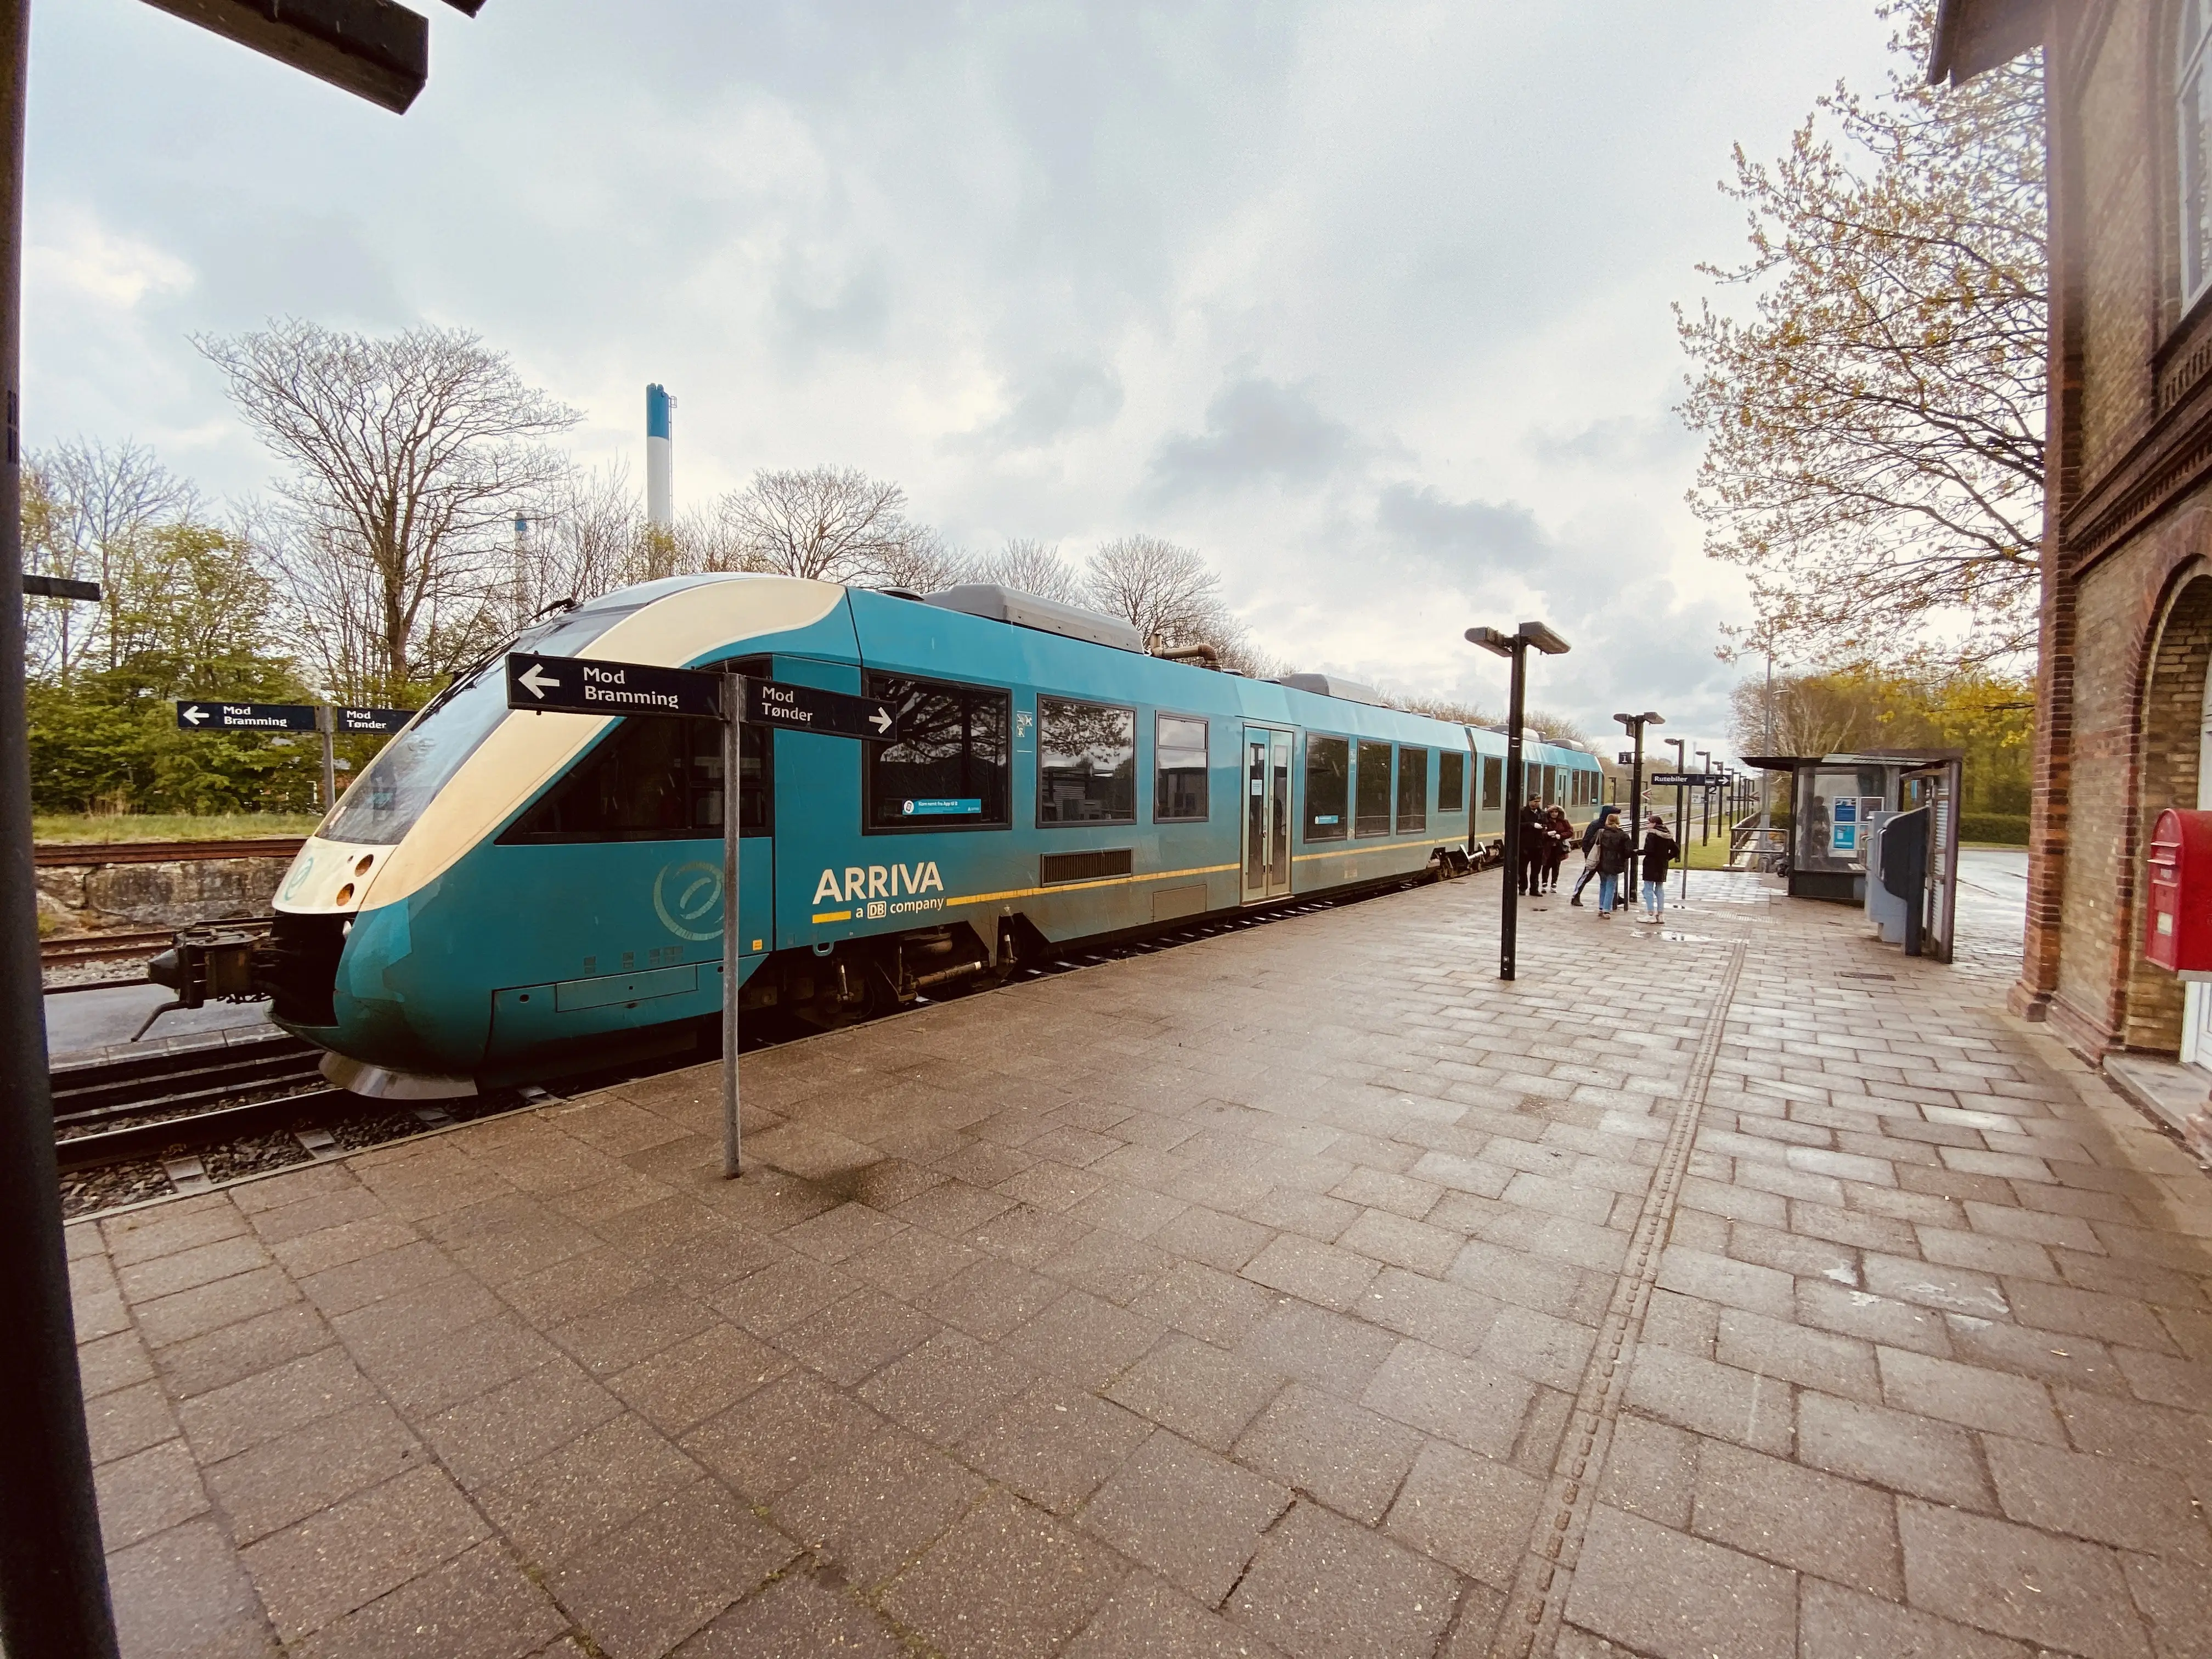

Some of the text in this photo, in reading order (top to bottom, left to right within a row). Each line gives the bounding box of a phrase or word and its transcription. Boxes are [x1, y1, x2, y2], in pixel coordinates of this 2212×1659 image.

[583, 667, 625, 684] Mod
[585, 685, 679, 709] Bramming
[763, 686, 794, 703] Mod
[223, 706, 251, 715] Mod
[346, 710, 371, 719] Mod
[761, 702, 813, 722] Tønder
[224, 716, 287, 727] Bramming
[346, 720, 387, 729] Tønder
[1708, 786, 1717, 794] 2
[812, 861, 944, 905] ARRIVA
[855, 897, 944, 918] a DB company
